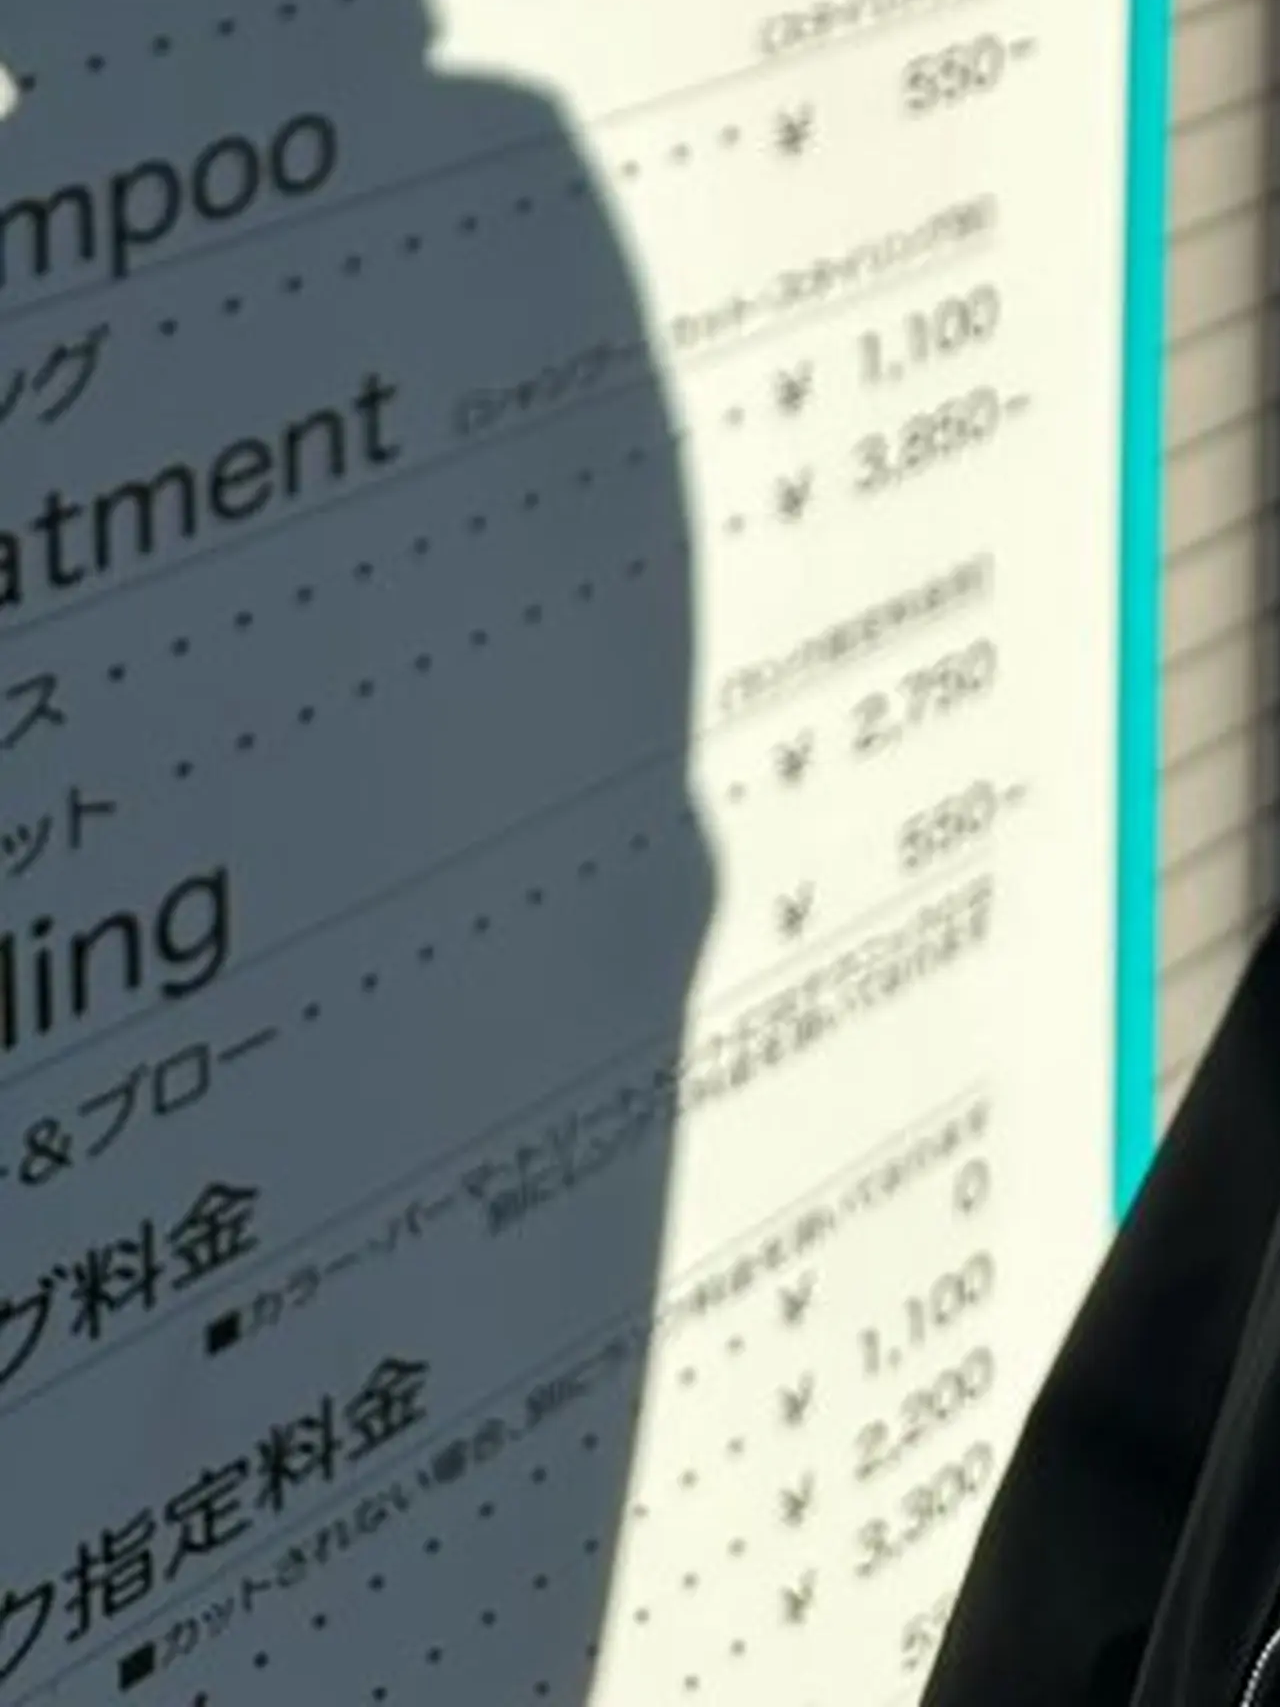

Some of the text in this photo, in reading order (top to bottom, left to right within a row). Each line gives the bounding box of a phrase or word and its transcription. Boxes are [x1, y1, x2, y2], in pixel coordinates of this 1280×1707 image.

[0, 113, 337, 277] mpoo
[857, 281, 1001, 387] 1,100
[0, 672, 67, 750] ス
[2, 786, 116, 877] ット
[0, 867, 228, 1052] ling
[0, 1027, 279, 1186] &ブロー
[859, 1251, 996, 1377] 1,100
[854, 1346, 995, 1482] 2,200
[855, 1440, 993, 1581] 3,300
